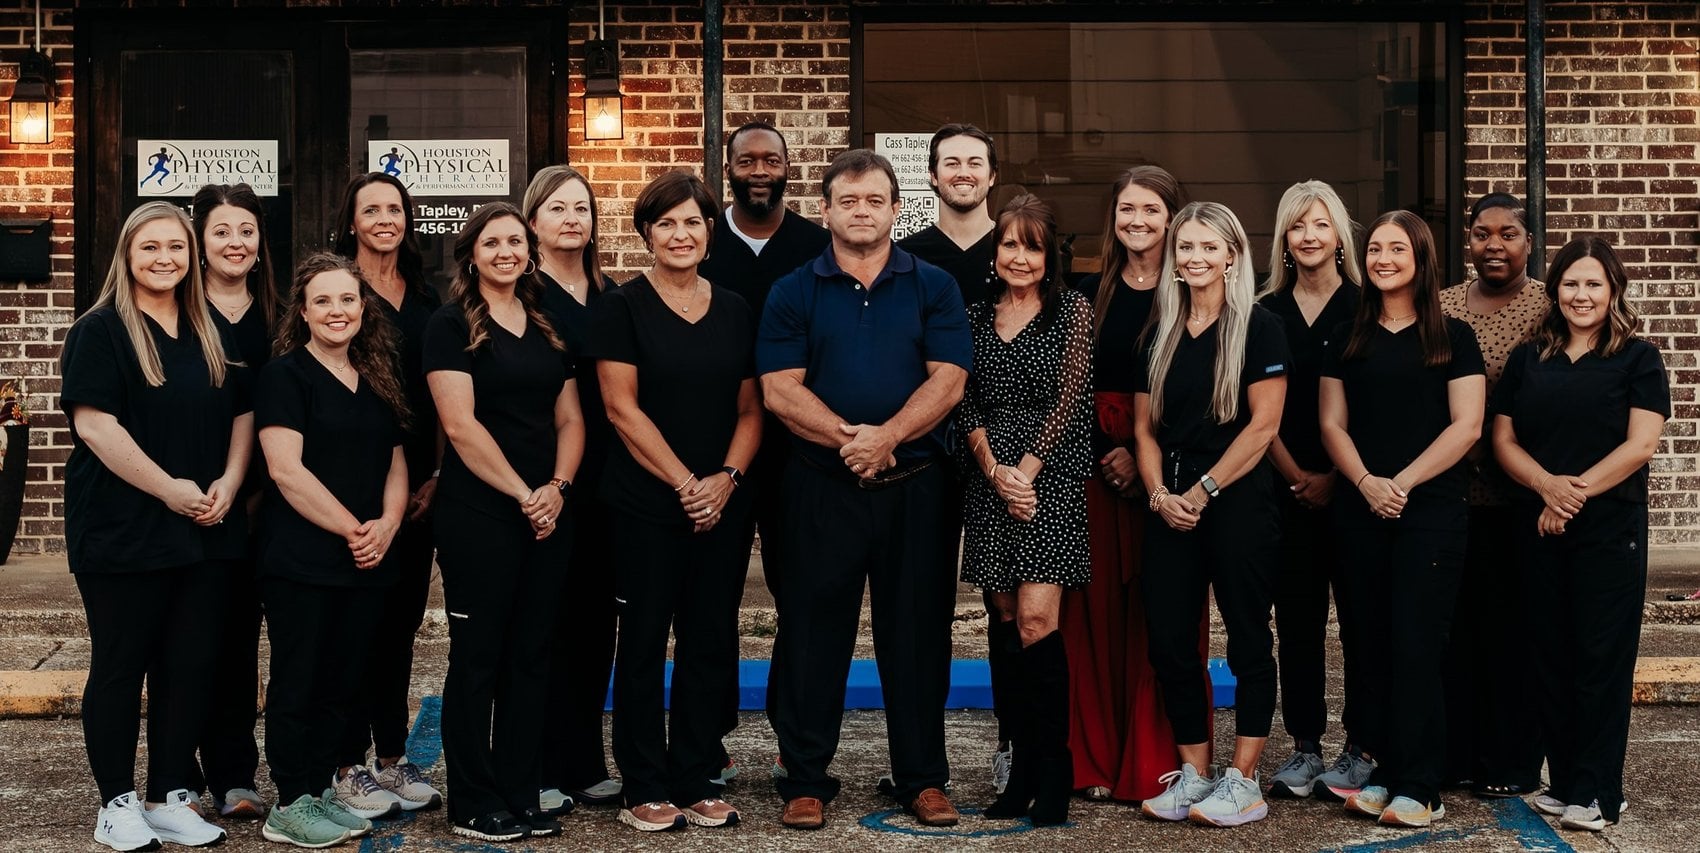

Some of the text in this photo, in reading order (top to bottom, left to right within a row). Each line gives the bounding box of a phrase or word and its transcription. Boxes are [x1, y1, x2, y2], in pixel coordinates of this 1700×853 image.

[885, 136, 903, 149] Cass
[192, 149, 260, 158] HOUSTON
[423, 148, 491, 158] HOUSTON
[892, 154, 900, 162] PH
[173, 159, 277, 174] PHYSICAL
[404, 158, 508, 173] PHYSICAL
[900, 166, 930, 174] 662-456-1
[172, 174, 277, 183] THERAPY
[403, 174, 507, 183] THERAPY
[418, 204, 469, 219] Tapley,
